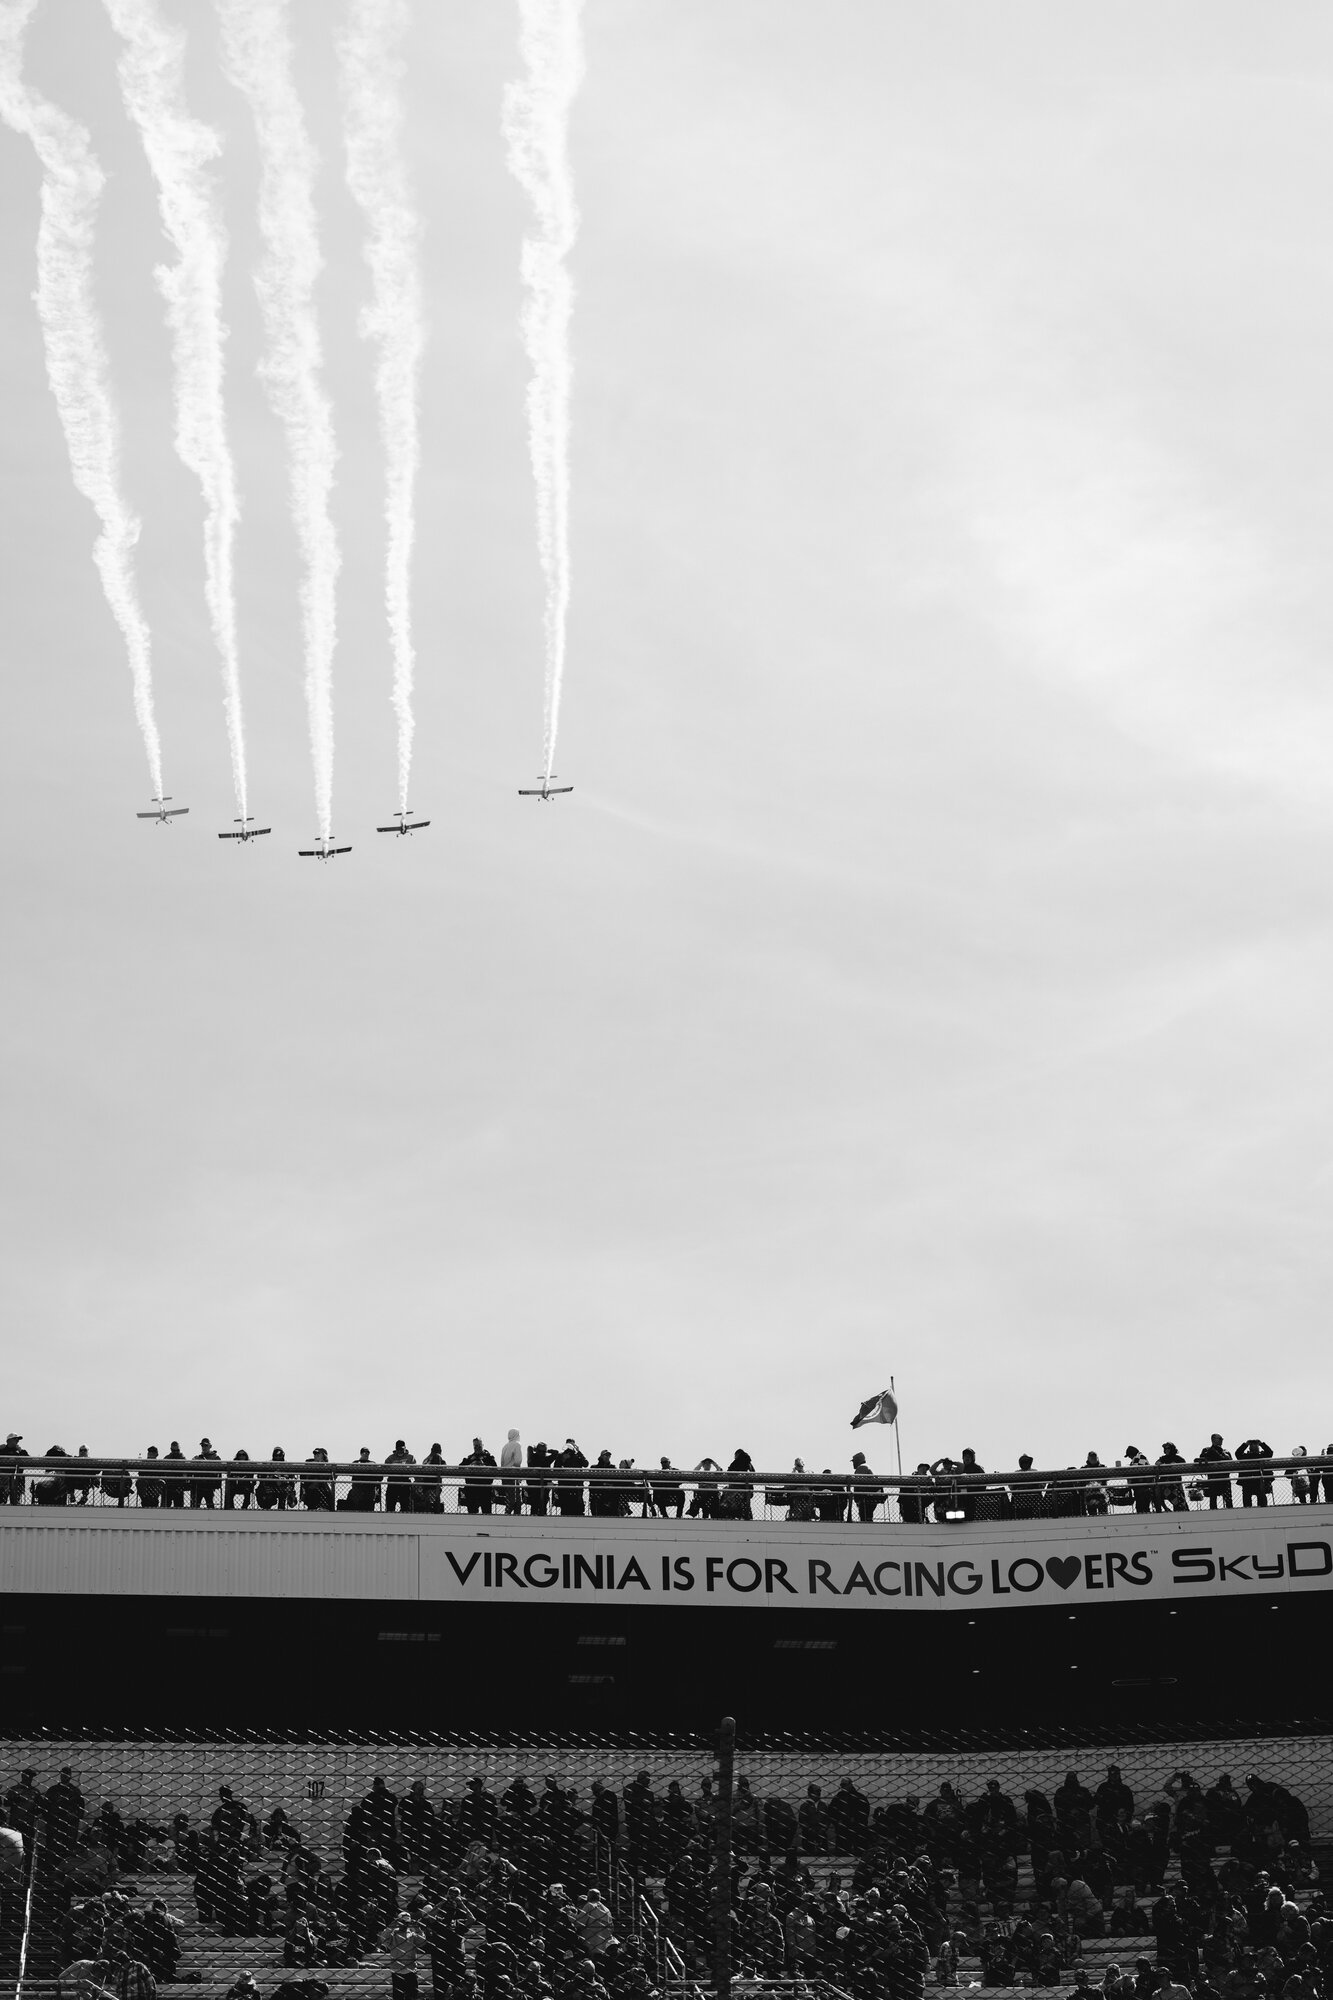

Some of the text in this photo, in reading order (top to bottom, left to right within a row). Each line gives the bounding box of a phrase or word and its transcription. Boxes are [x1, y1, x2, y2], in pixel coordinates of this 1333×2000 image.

[444, 1551, 652, 1591] VIRGINIA
[661, 1555, 695, 1593] IS
[705, 1556, 799, 1594] FOR
[808, 1559, 983, 1597] RACING
[307, 1780, 325, 1799] 107
